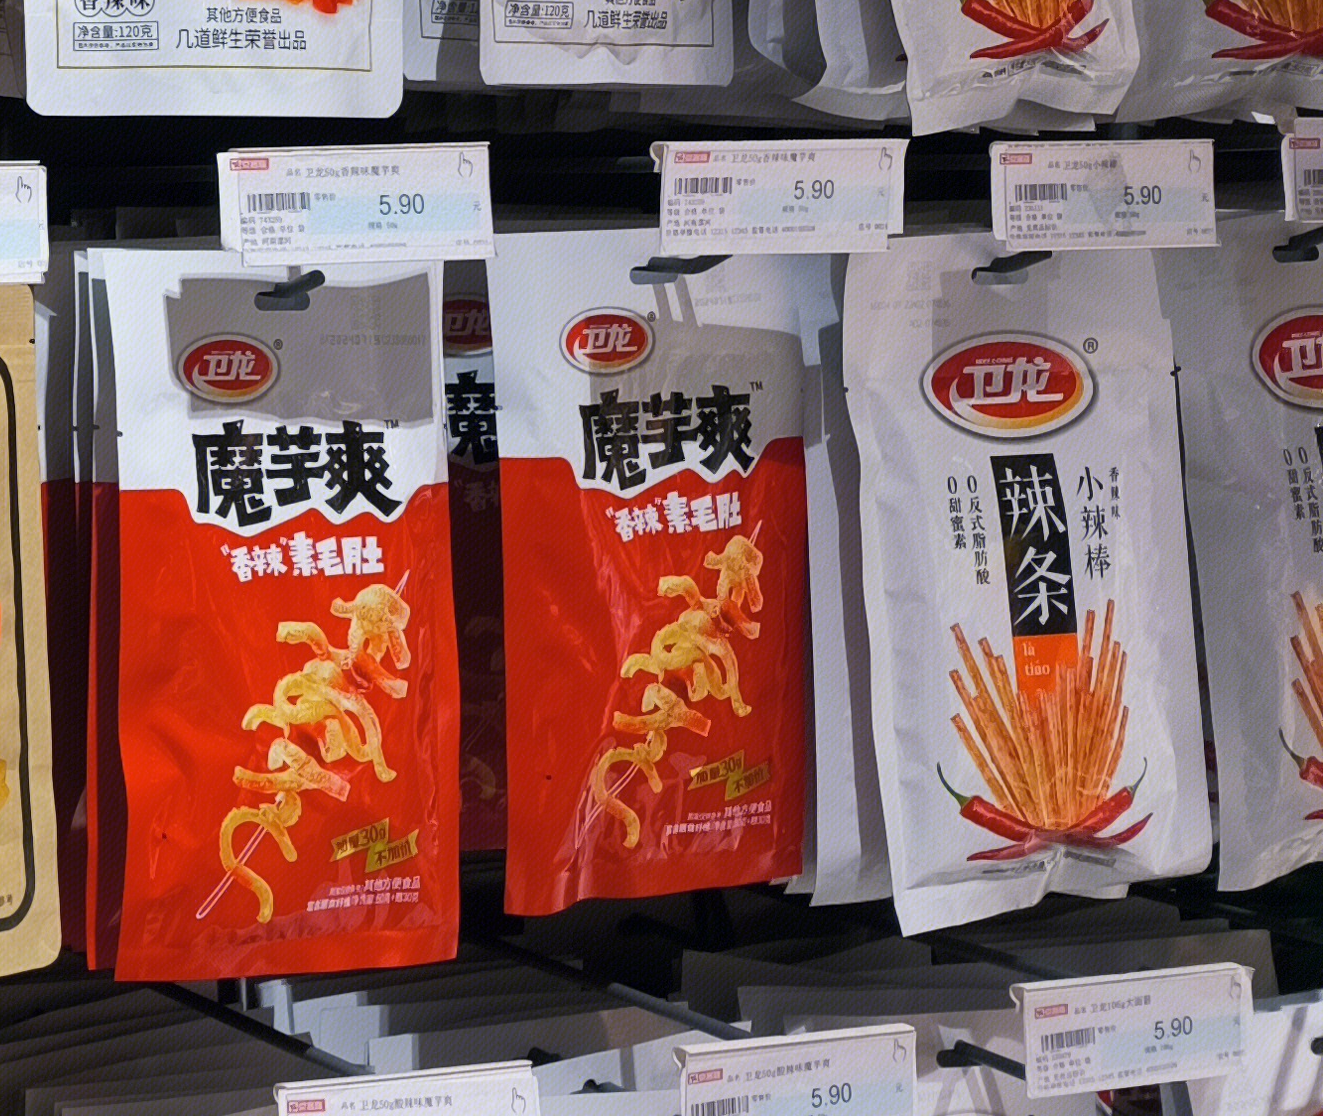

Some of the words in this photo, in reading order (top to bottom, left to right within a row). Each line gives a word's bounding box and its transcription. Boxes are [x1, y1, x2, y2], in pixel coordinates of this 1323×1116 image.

[205, 6, 282, 24] 其他方便食品
[176, 28, 307, 51] 几道鲜生荣誉出品
[794, 179, 835, 200] 5.90
[1123, 185, 1162, 206] 5.90
[379, 193, 425, 216] 5.90
[573, 324, 637, 353] 卫龙
[192, 350, 261, 382] 卫龙
[951, 357, 1064, 405] 卫龙
[579, 384, 755, 490] 魔芋爽
[192, 419, 403, 527] 魔芋爽
[1076, 467, 1111, 580] 小辣棒
[999, 465, 1072, 626] 辣条
[1154, 1015, 1193, 1040] 5.90
[811, 1082, 852, 1109] 5.90
